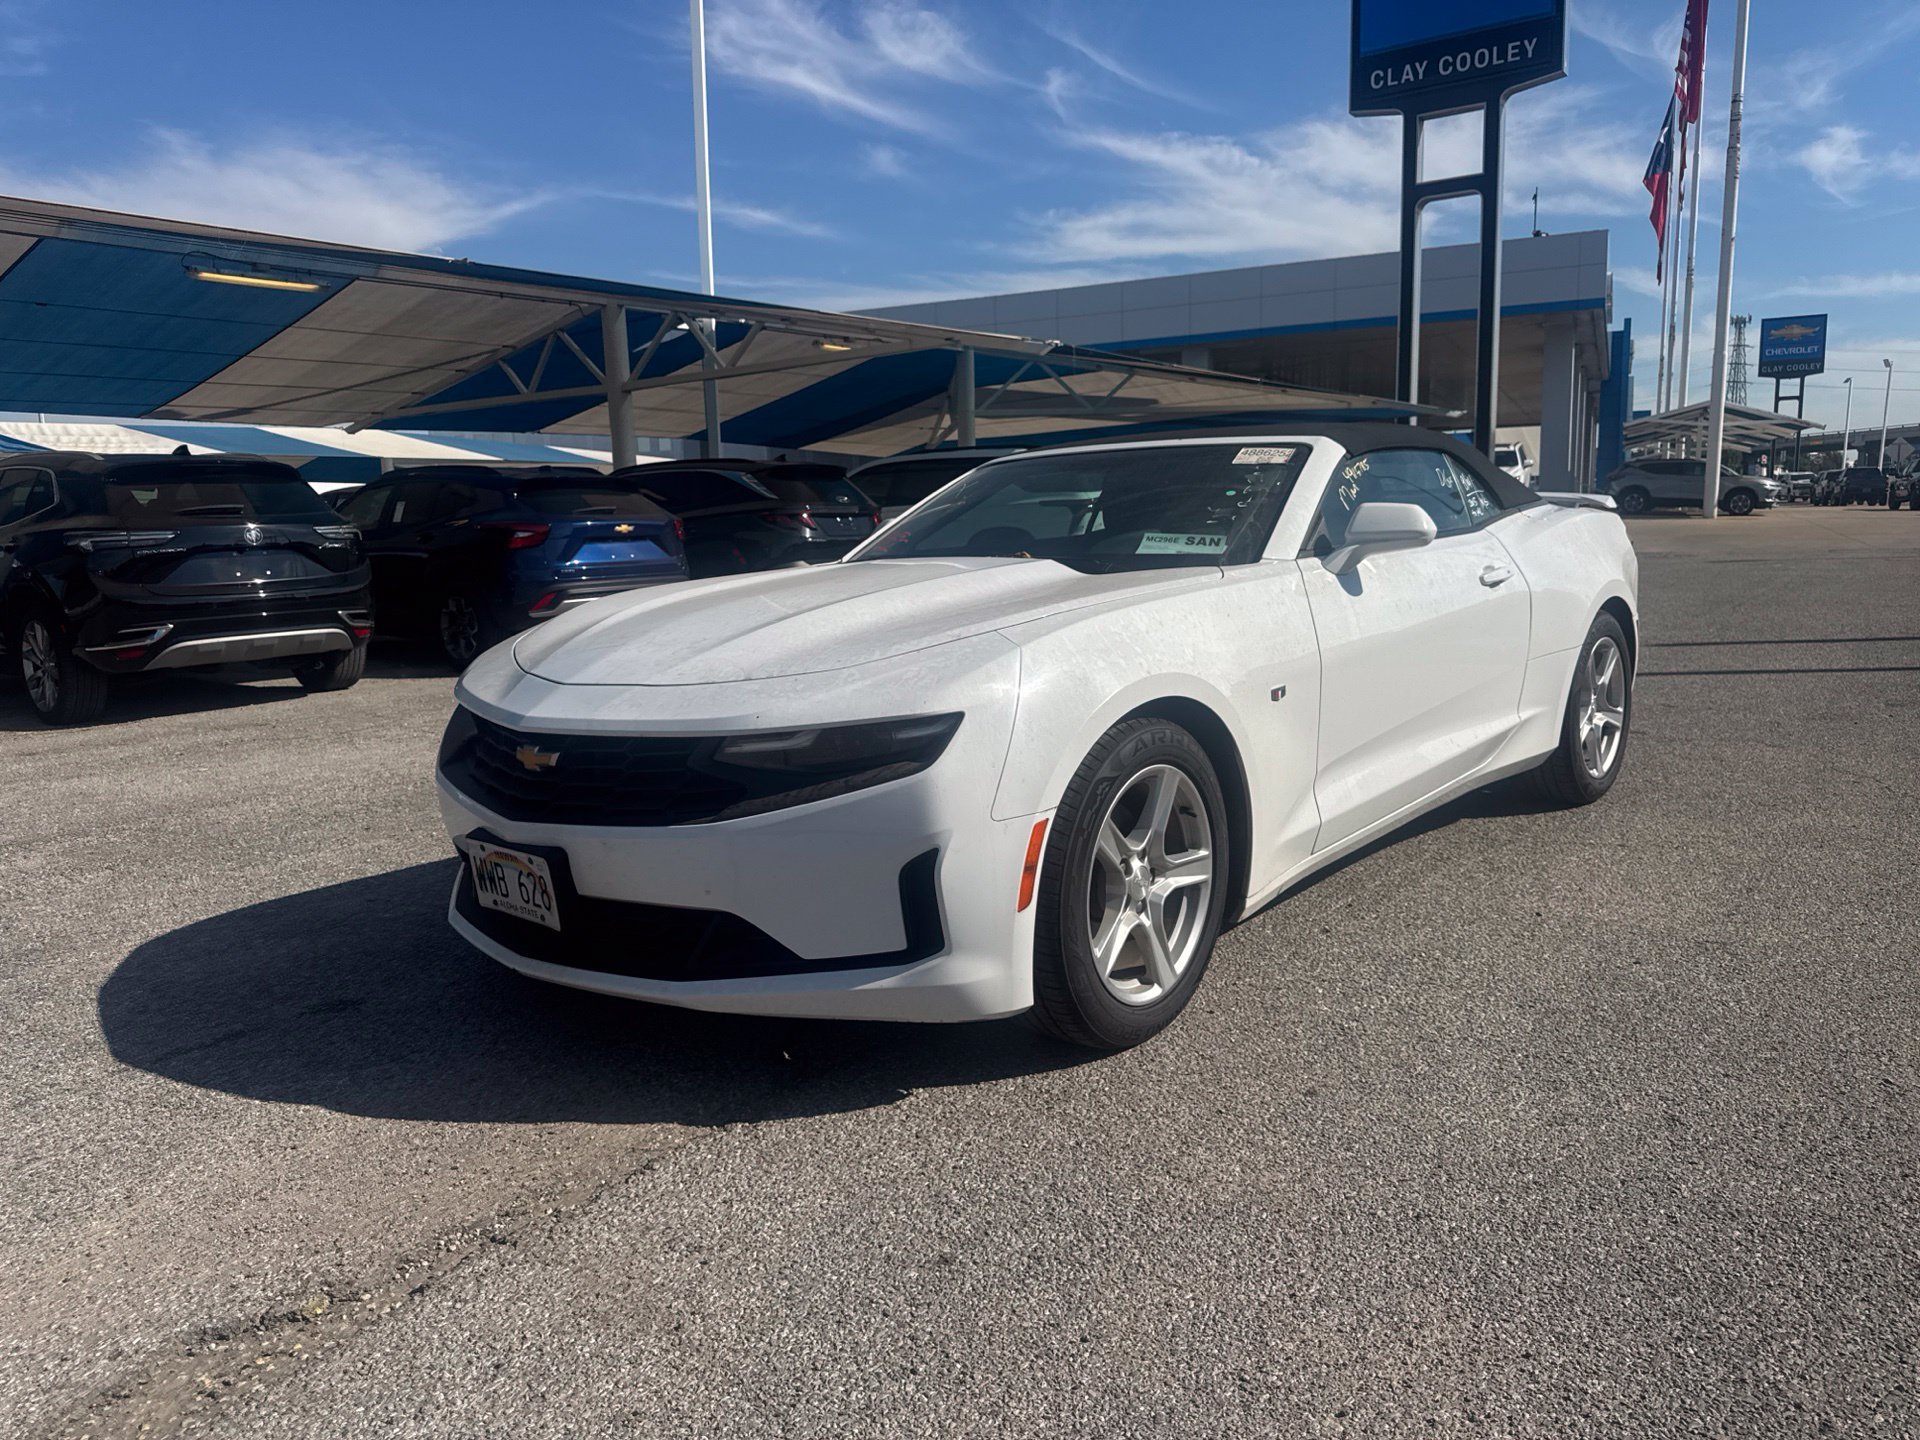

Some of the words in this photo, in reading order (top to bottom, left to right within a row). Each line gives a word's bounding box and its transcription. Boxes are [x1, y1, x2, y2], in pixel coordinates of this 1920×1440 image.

[1370, 60, 1428, 89] CLAY
[1438, 37, 1538, 76] COOLEY
[1766, 346, 1819, 356] CHEVROLET
[1787, 363, 1821, 371] COOLEY
[1185, 536, 1222, 547] SAN
[518, 870, 552, 911] 628
[520, 907, 539, 918] STATE
